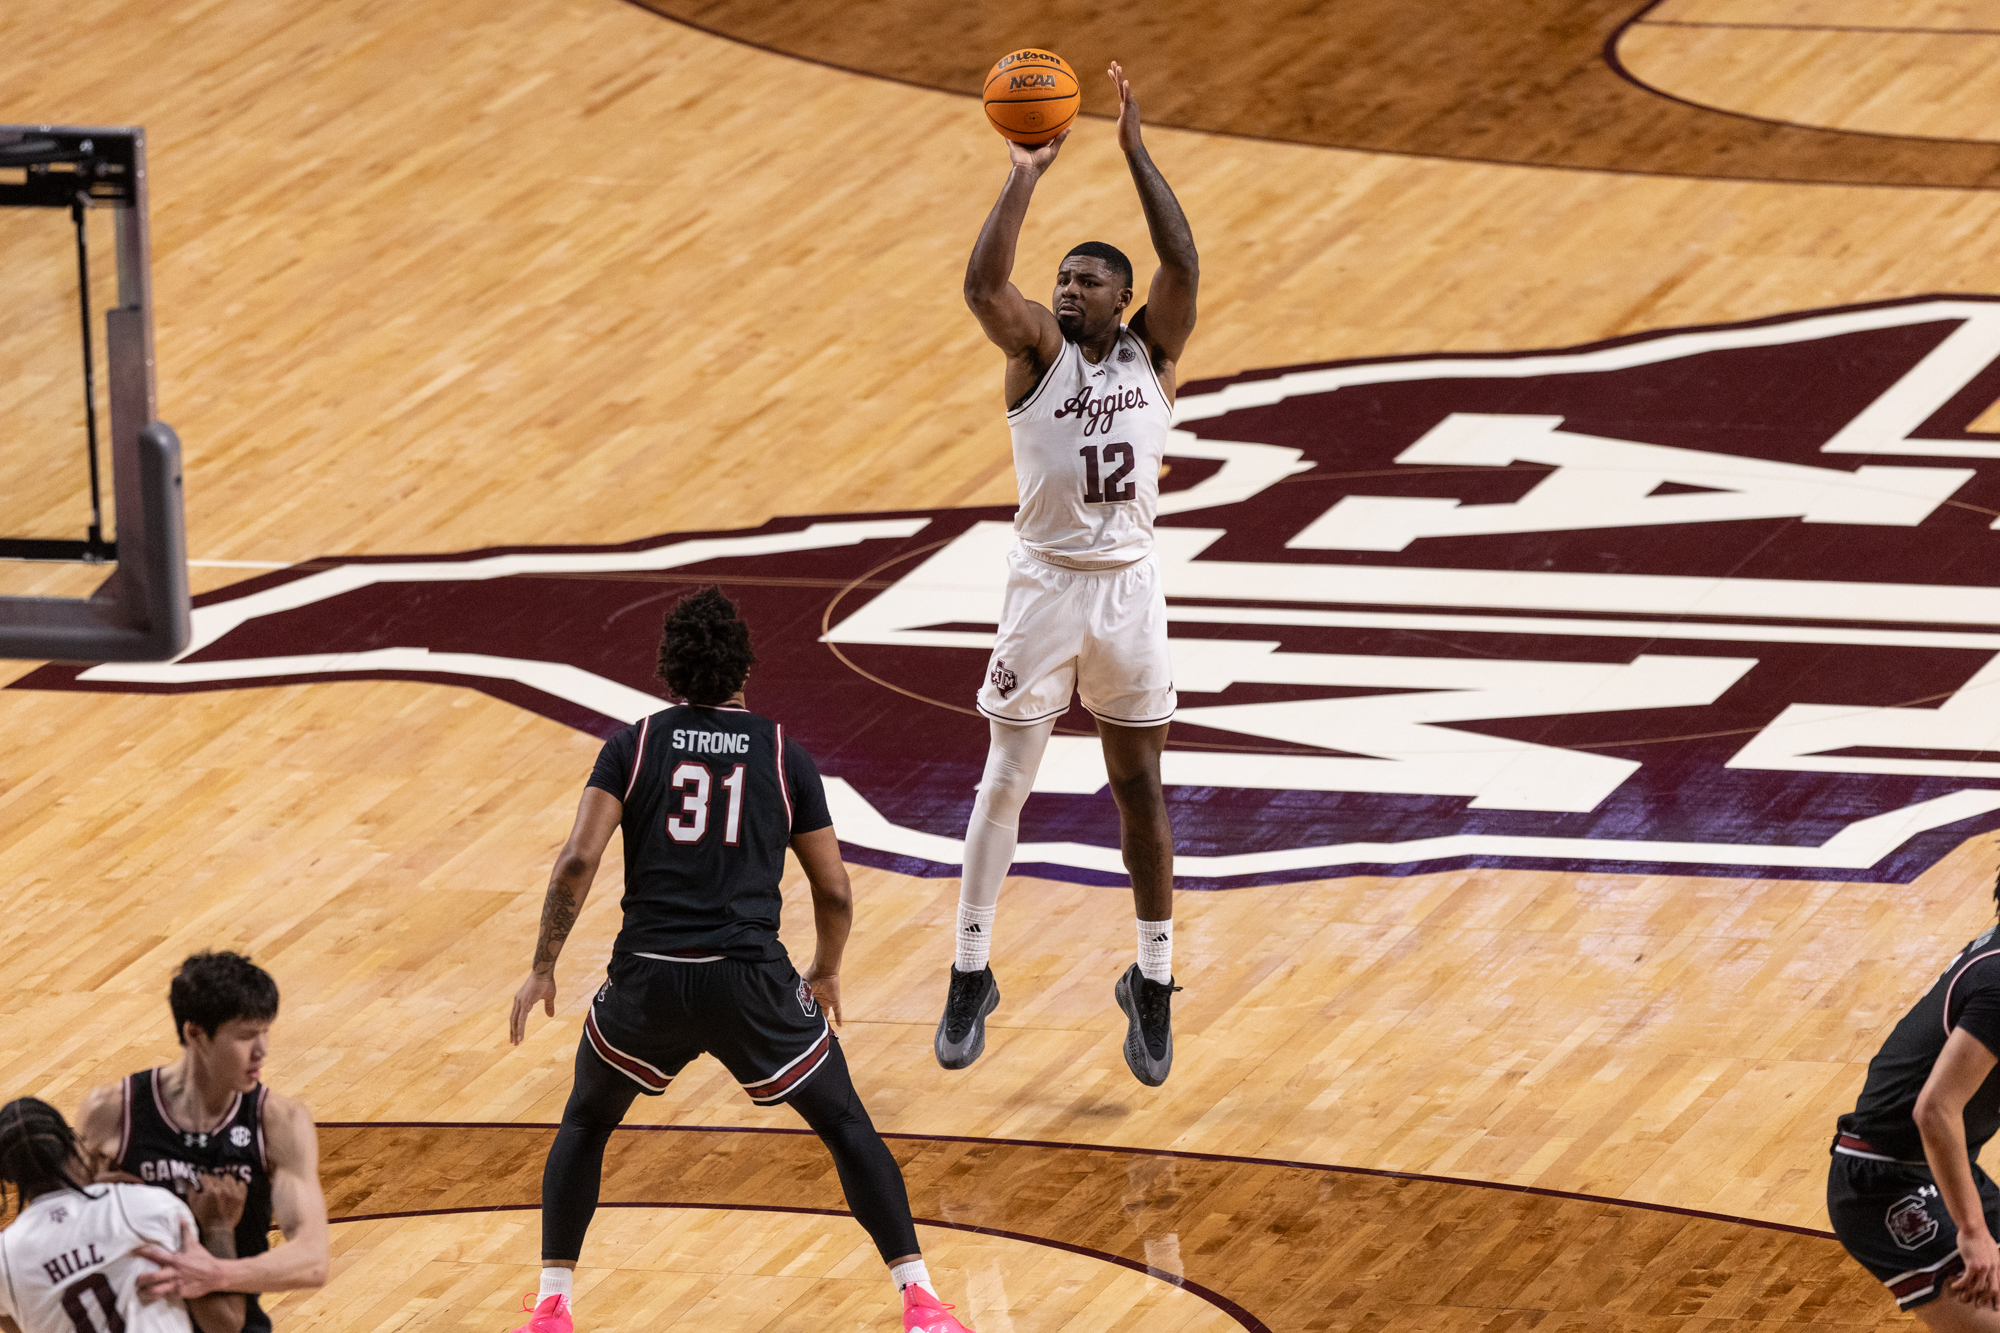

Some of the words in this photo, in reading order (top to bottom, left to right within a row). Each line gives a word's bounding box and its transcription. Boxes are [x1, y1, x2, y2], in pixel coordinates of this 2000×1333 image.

[998, 50, 1061, 69] Wilson
[1009, 74, 1056, 90] NCAA
[1054, 384, 1149, 437] Aggies
[1079, 441, 1136, 504] 12
[672, 729, 750, 754] STRONG
[666, 760, 747, 848] 31
[43, 1243, 104, 1284] HILL
[61, 1273, 126, 1333] 0
